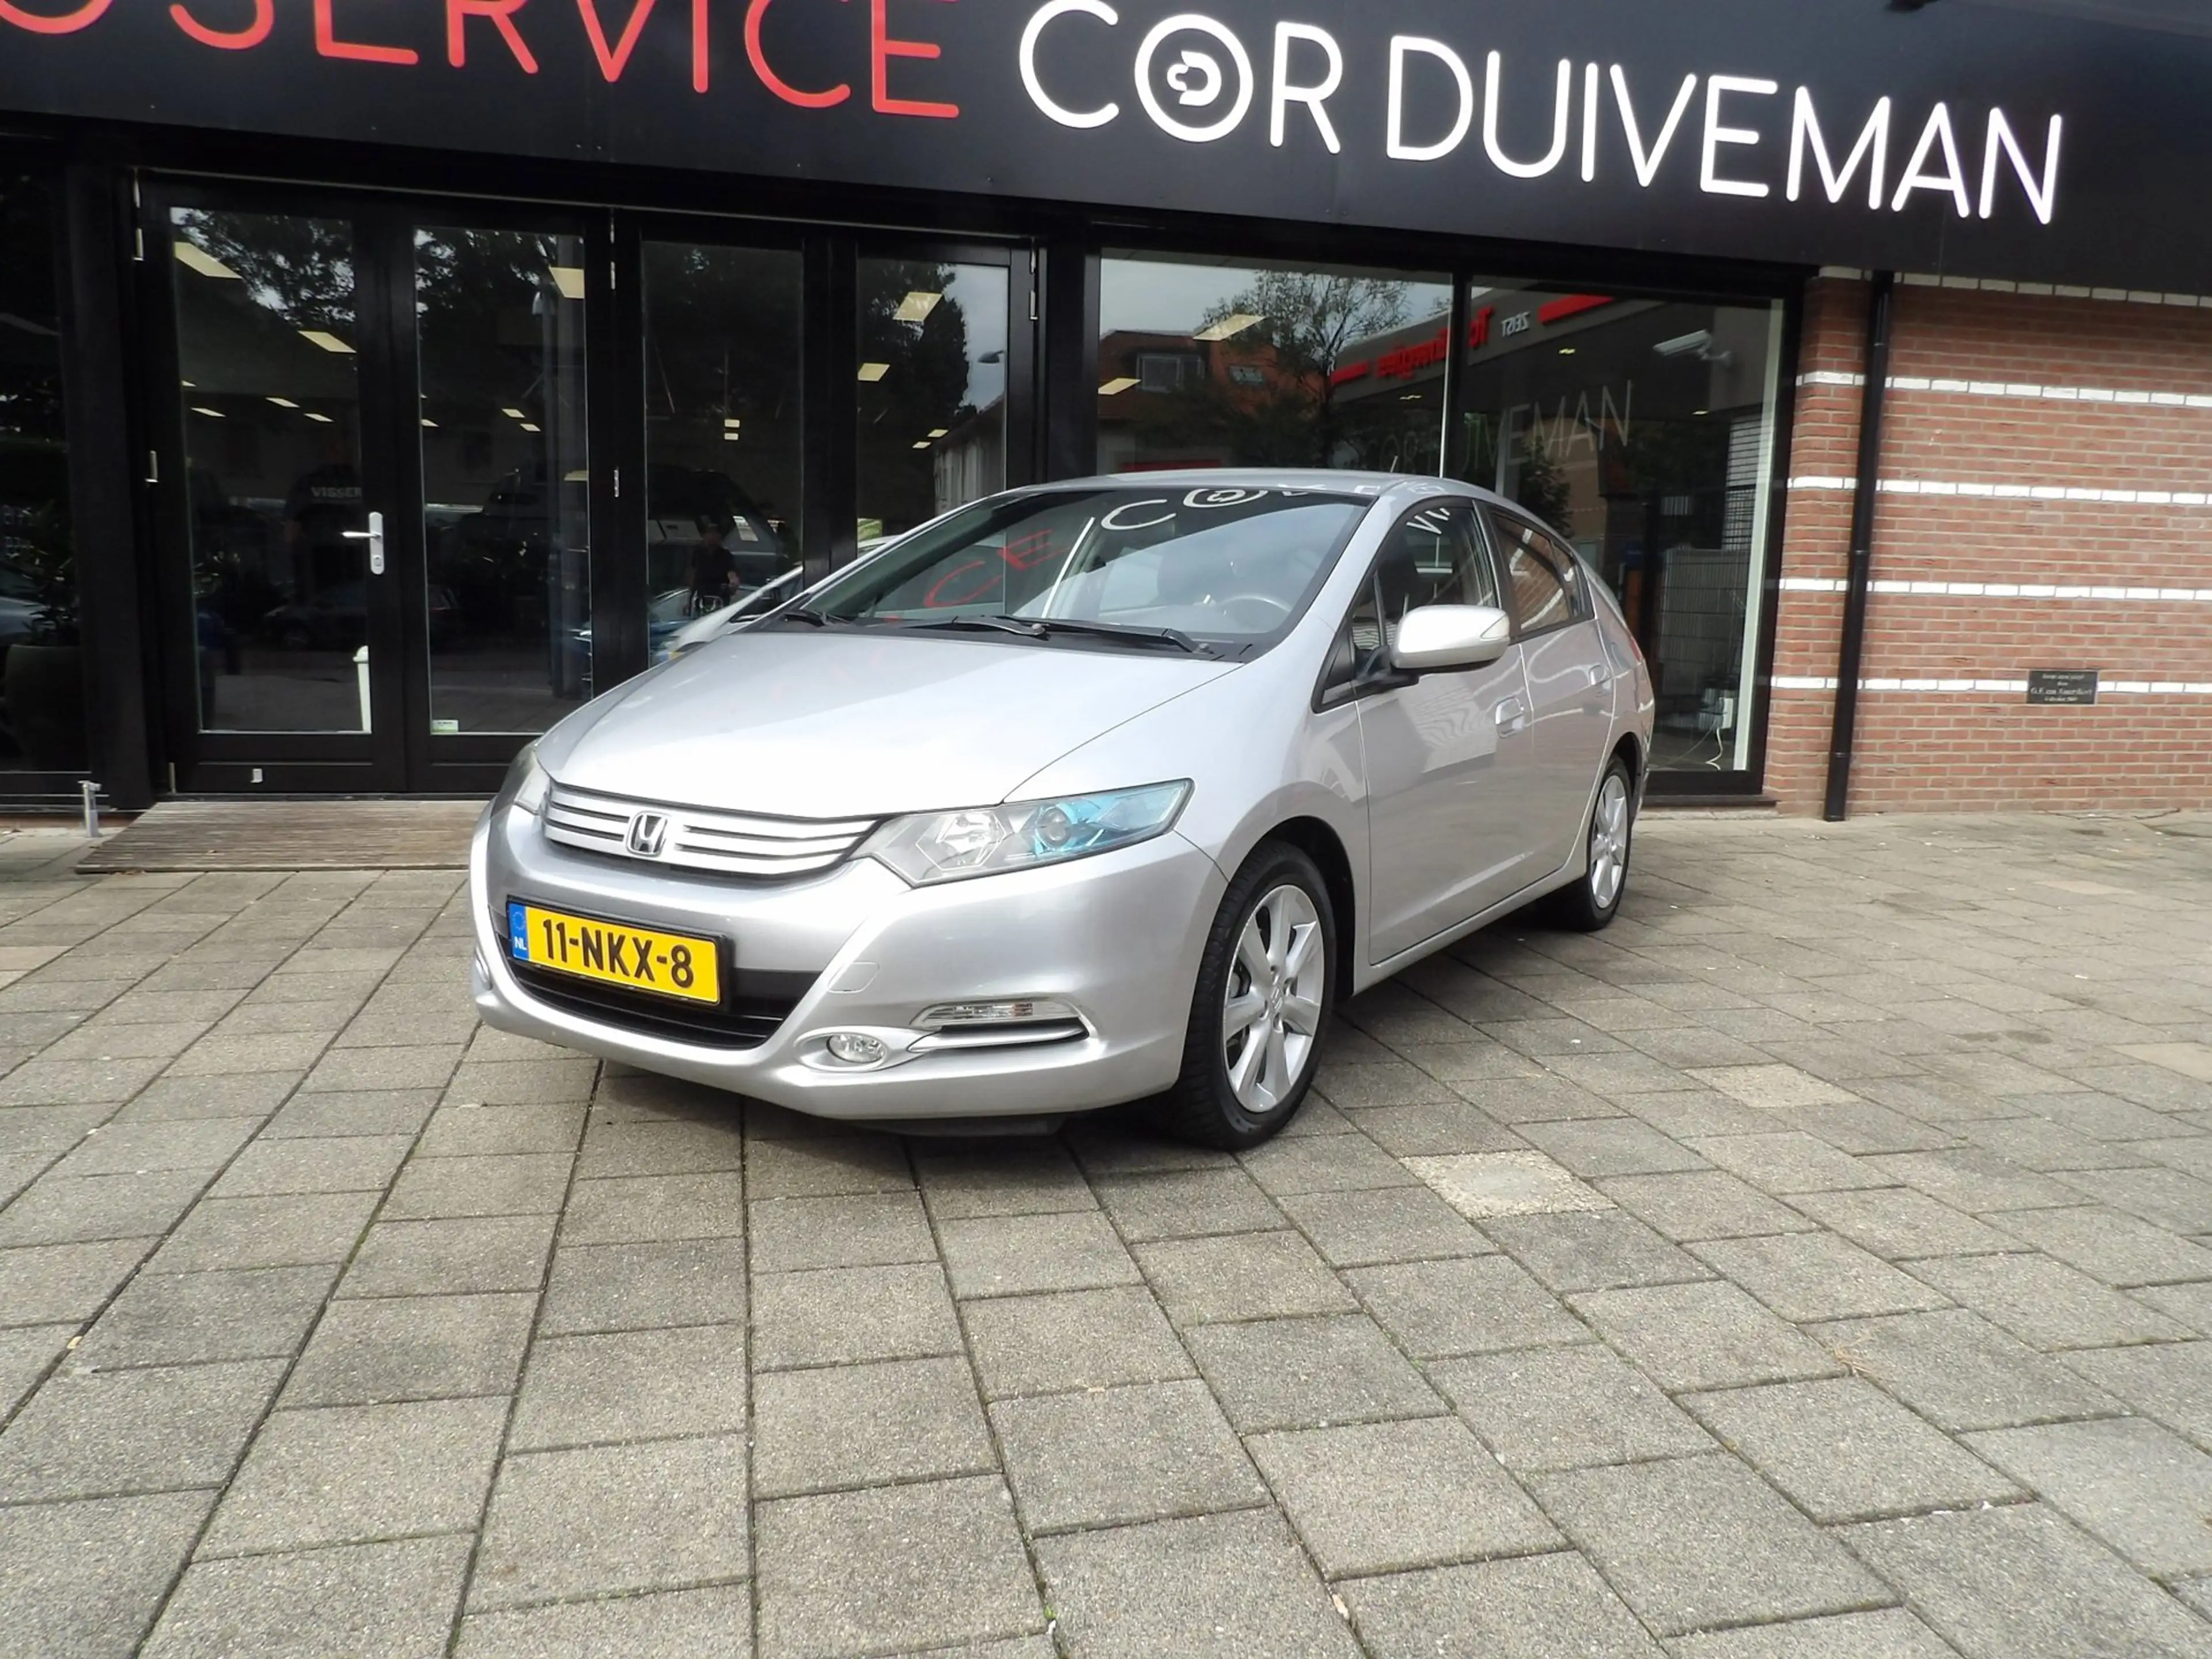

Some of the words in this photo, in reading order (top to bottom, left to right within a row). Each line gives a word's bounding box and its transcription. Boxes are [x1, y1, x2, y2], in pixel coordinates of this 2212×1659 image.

[1018, 0, 1343, 153] COR
[1387, 35, 2063, 224] DUIVEMAN
[514, 935, 527, 951] NL
[543, 919, 694, 988] 11-NKX-8
